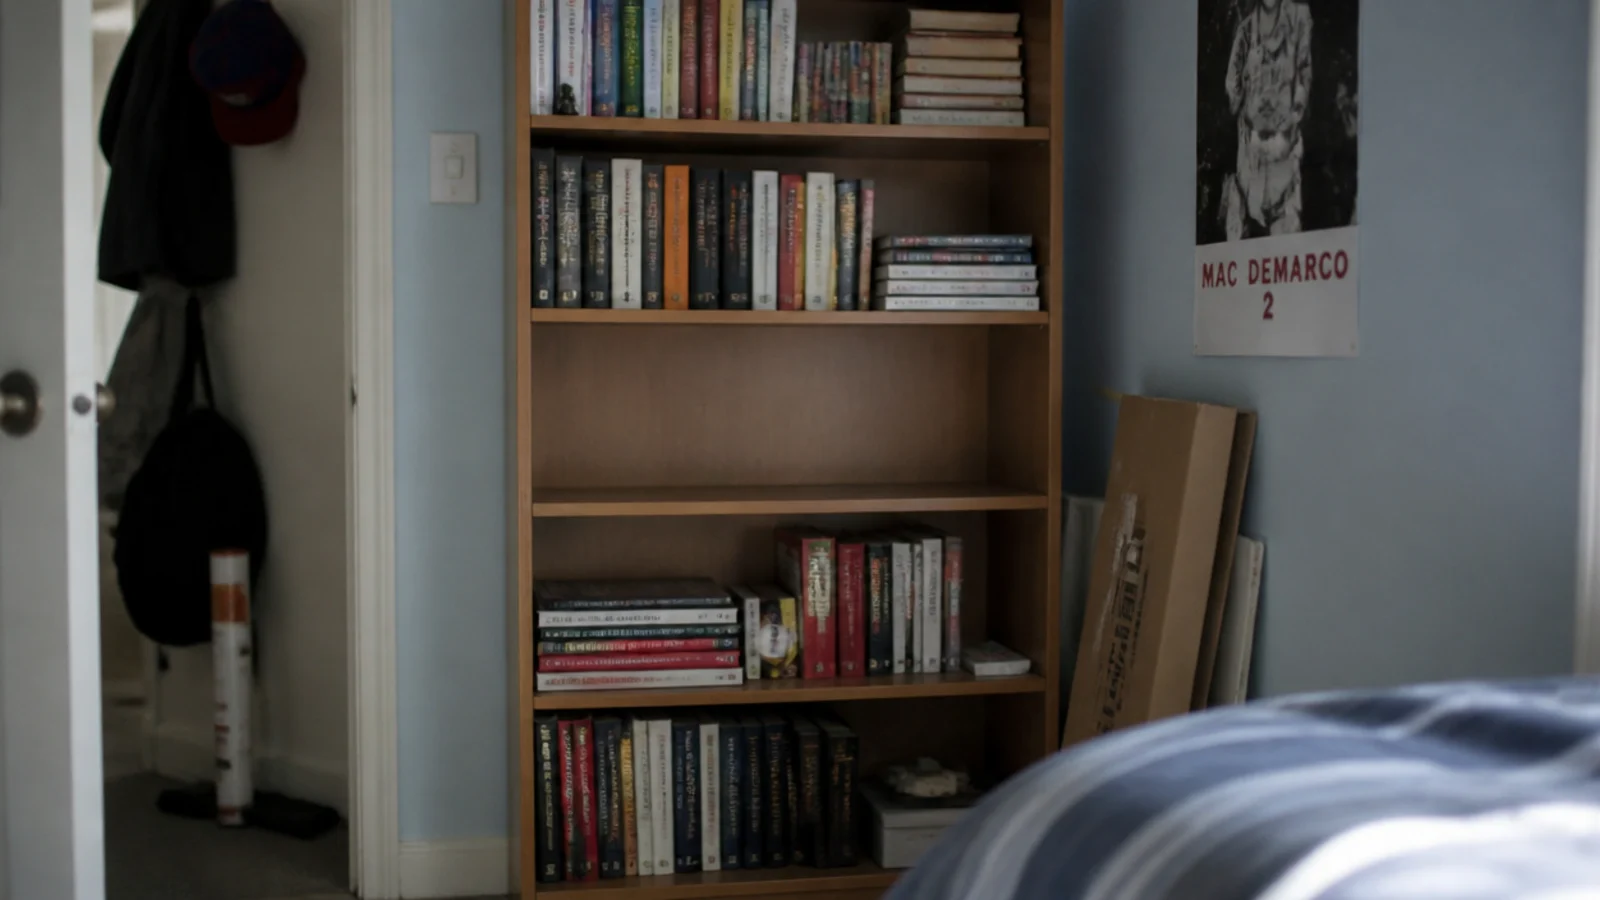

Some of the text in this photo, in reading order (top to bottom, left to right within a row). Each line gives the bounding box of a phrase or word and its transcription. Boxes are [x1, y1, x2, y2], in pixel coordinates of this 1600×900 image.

[1202, 249, 1349, 288] MAC DEMARCO
[1262, 291, 1274, 320] 2
